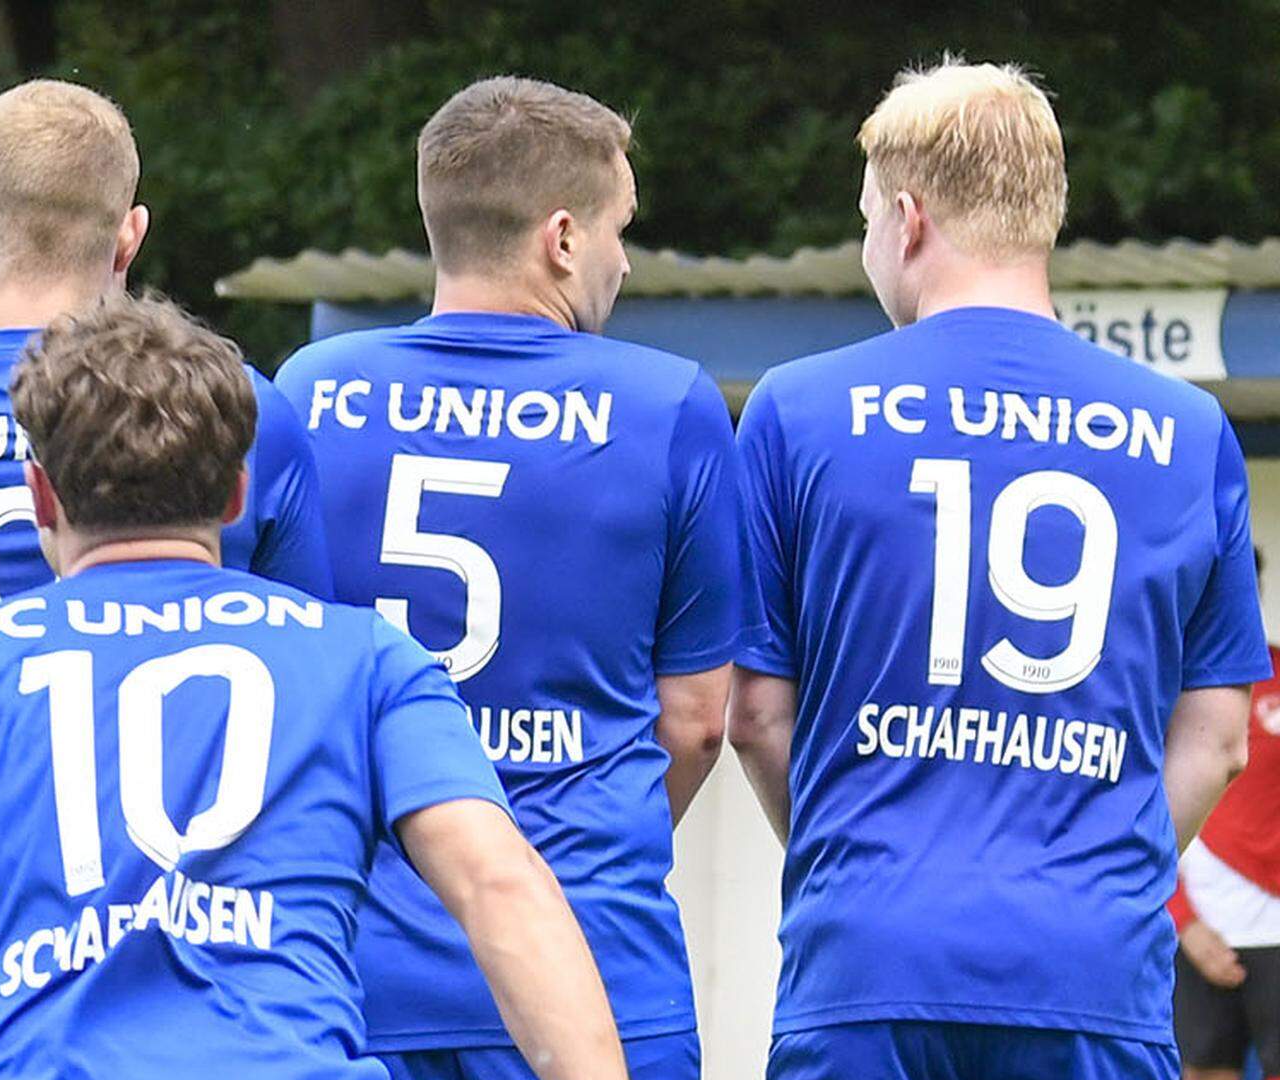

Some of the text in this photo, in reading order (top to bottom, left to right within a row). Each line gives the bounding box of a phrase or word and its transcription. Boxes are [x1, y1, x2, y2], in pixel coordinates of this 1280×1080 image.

[307, 379, 613, 445] FC UNION
[849, 384, 1176, 467] FC UNION
[374, 453, 512, 684] 5
[908, 457, 1119, 695] 19
[65, 591, 325, 637] UNION
[932, 657, 960, 670] 1910
[1021, 663, 1052, 680] 1910
[18, 642, 276, 897] 10
[855, 702, 1128, 784] SCHAFHAUSEN
